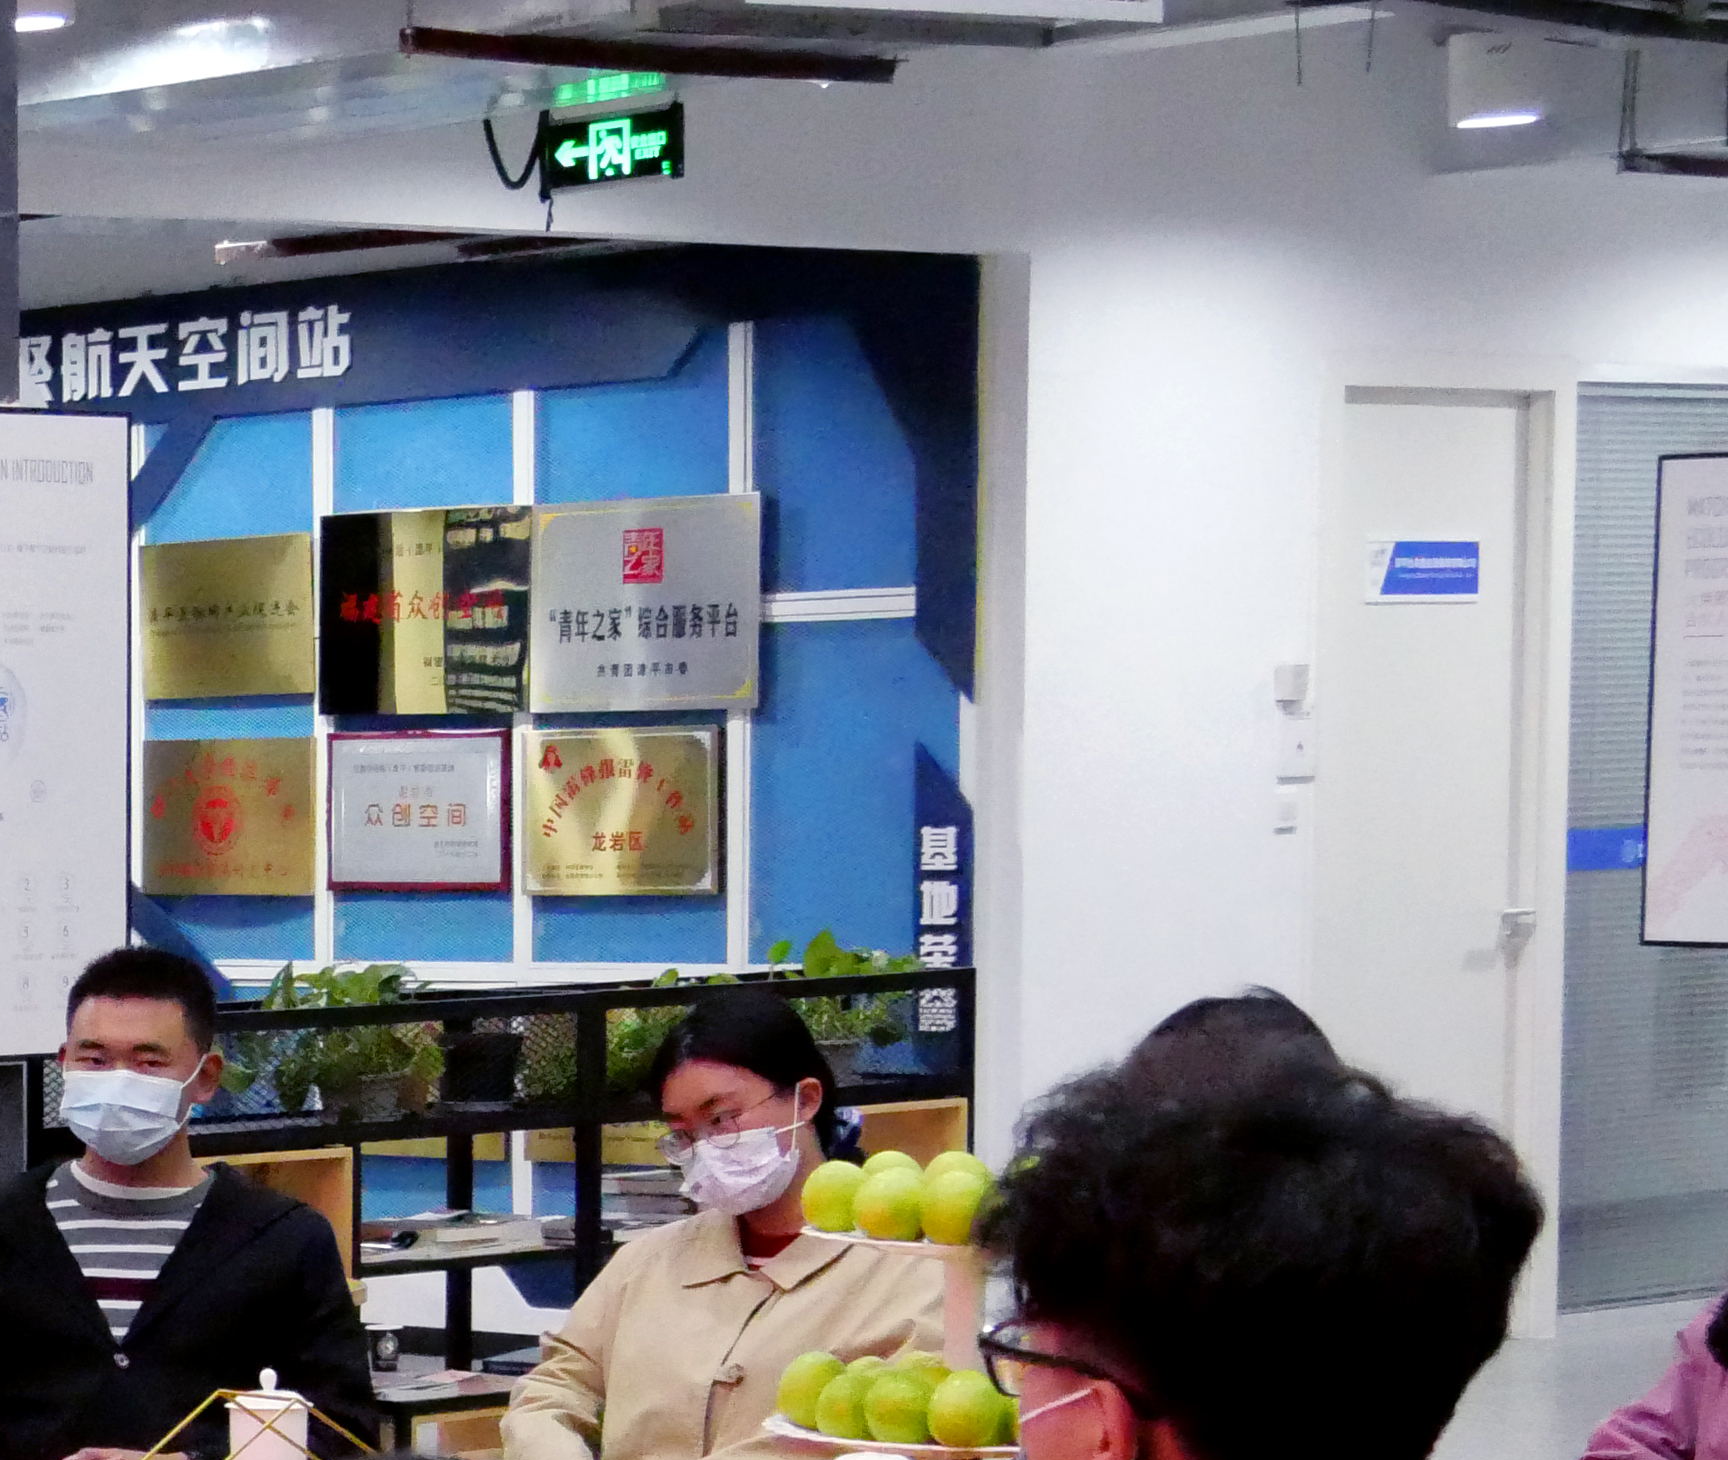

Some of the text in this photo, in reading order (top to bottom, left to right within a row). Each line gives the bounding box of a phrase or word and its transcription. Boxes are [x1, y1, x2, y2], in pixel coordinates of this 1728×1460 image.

[12, 459, 94, 485] INTRODUCTION
[365, 803, 466, 827] 众创空间
